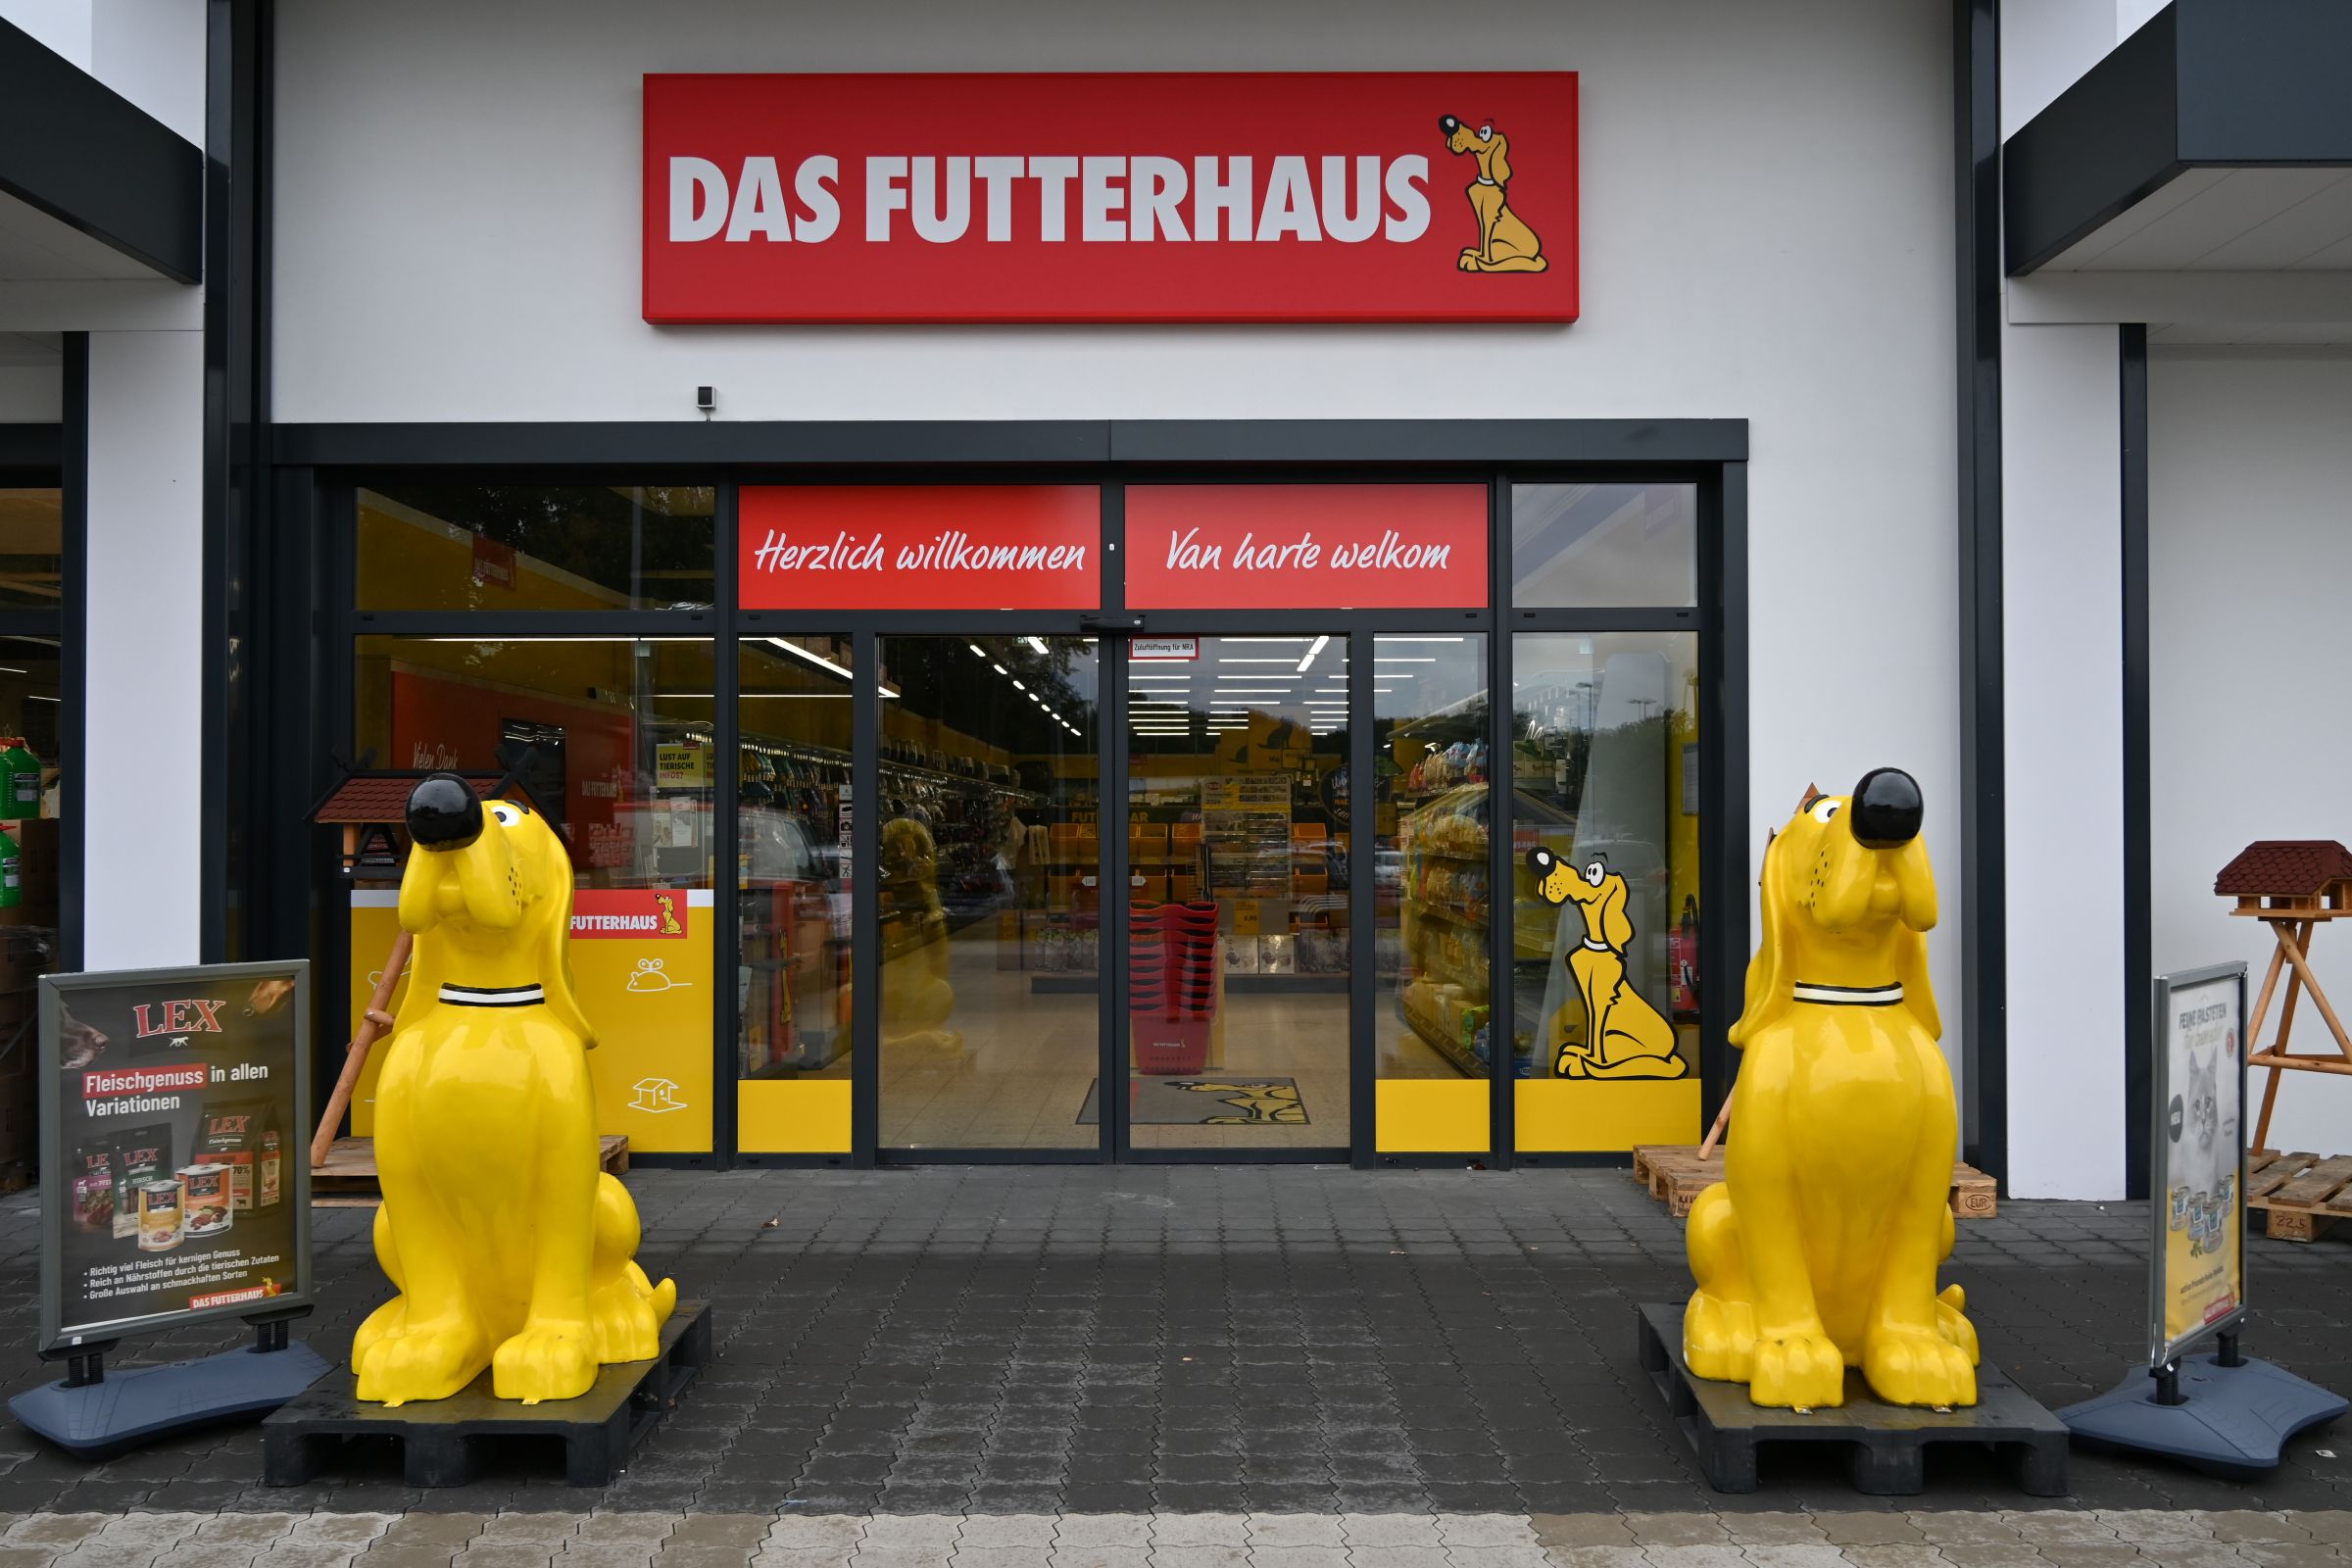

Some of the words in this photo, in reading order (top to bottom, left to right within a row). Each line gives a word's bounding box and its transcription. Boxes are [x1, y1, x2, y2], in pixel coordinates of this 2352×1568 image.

[669, 154, 840, 244] DAS
[865, 154, 1431, 244] FUTTERHAUS
[755, 529, 885, 572] Herzlich
[896, 532, 1086, 572] willkommen
[1166, 527, 1222, 570] Van
[1236, 529, 1320, 570] harte
[1331, 530, 1451, 570] welkom
[1134, 643, 1171, 653] Zuluftöffnung
[413, 740, 435, 770] Vielen
[436, 743, 459, 770] Dank
[659, 753, 676, 761] LUST
[677, 752, 691, 760] AUF
[659, 761, 695, 770] TIERISCHE
[659, 771, 684, 780] INFOS?
[569, 914, 658, 930] FUTTERHAUS
[132, 999, 226, 1039] LEX
[2179, 1009, 2196, 1030] FEINE
[85, 1067, 204, 1094] Fleischgenuss
[210, 1065, 225, 1083] in
[230, 1063, 269, 1081] allen
[85, 1095, 180, 1117] Variationen
[208, 1115, 251, 1136] LEX
[86, 1152, 111, 1169] LE
[123, 1148, 159, 1167] LEX
[188, 1175, 220, 1190] LEX
[147, 1191, 176, 1206] LEX
[1970, 1197, 1987, 1208] EUR
[89, 1278, 112, 1289] Reich
[125, 1270, 173, 1283] Nährstoffen
[174, 1265, 197, 1276] durch
[198, 1263, 210, 1273] die
[211, 1258, 250, 1271] tierischen
[251, 1254, 280, 1265] Zutaten
[90, 1266, 118, 1277] Richtig
[119, 1263, 134, 1272] viel
[135, 1258, 164, 1270] Fleisch
[165, 1256, 176, 1266] für
[178, 1252, 212, 1265] kernigen
[213, 1250, 240, 1260] Genuss
[89, 1289, 114, 1300] Große
[115, 1284, 149, 1297] Auswahl
[162, 1275, 221, 1290] schmackhaften
[222, 1270, 248, 1280] Sorten
[192, 1298, 211, 1309] DAS
[211, 1289, 264, 1307] FUTTERHAUS
